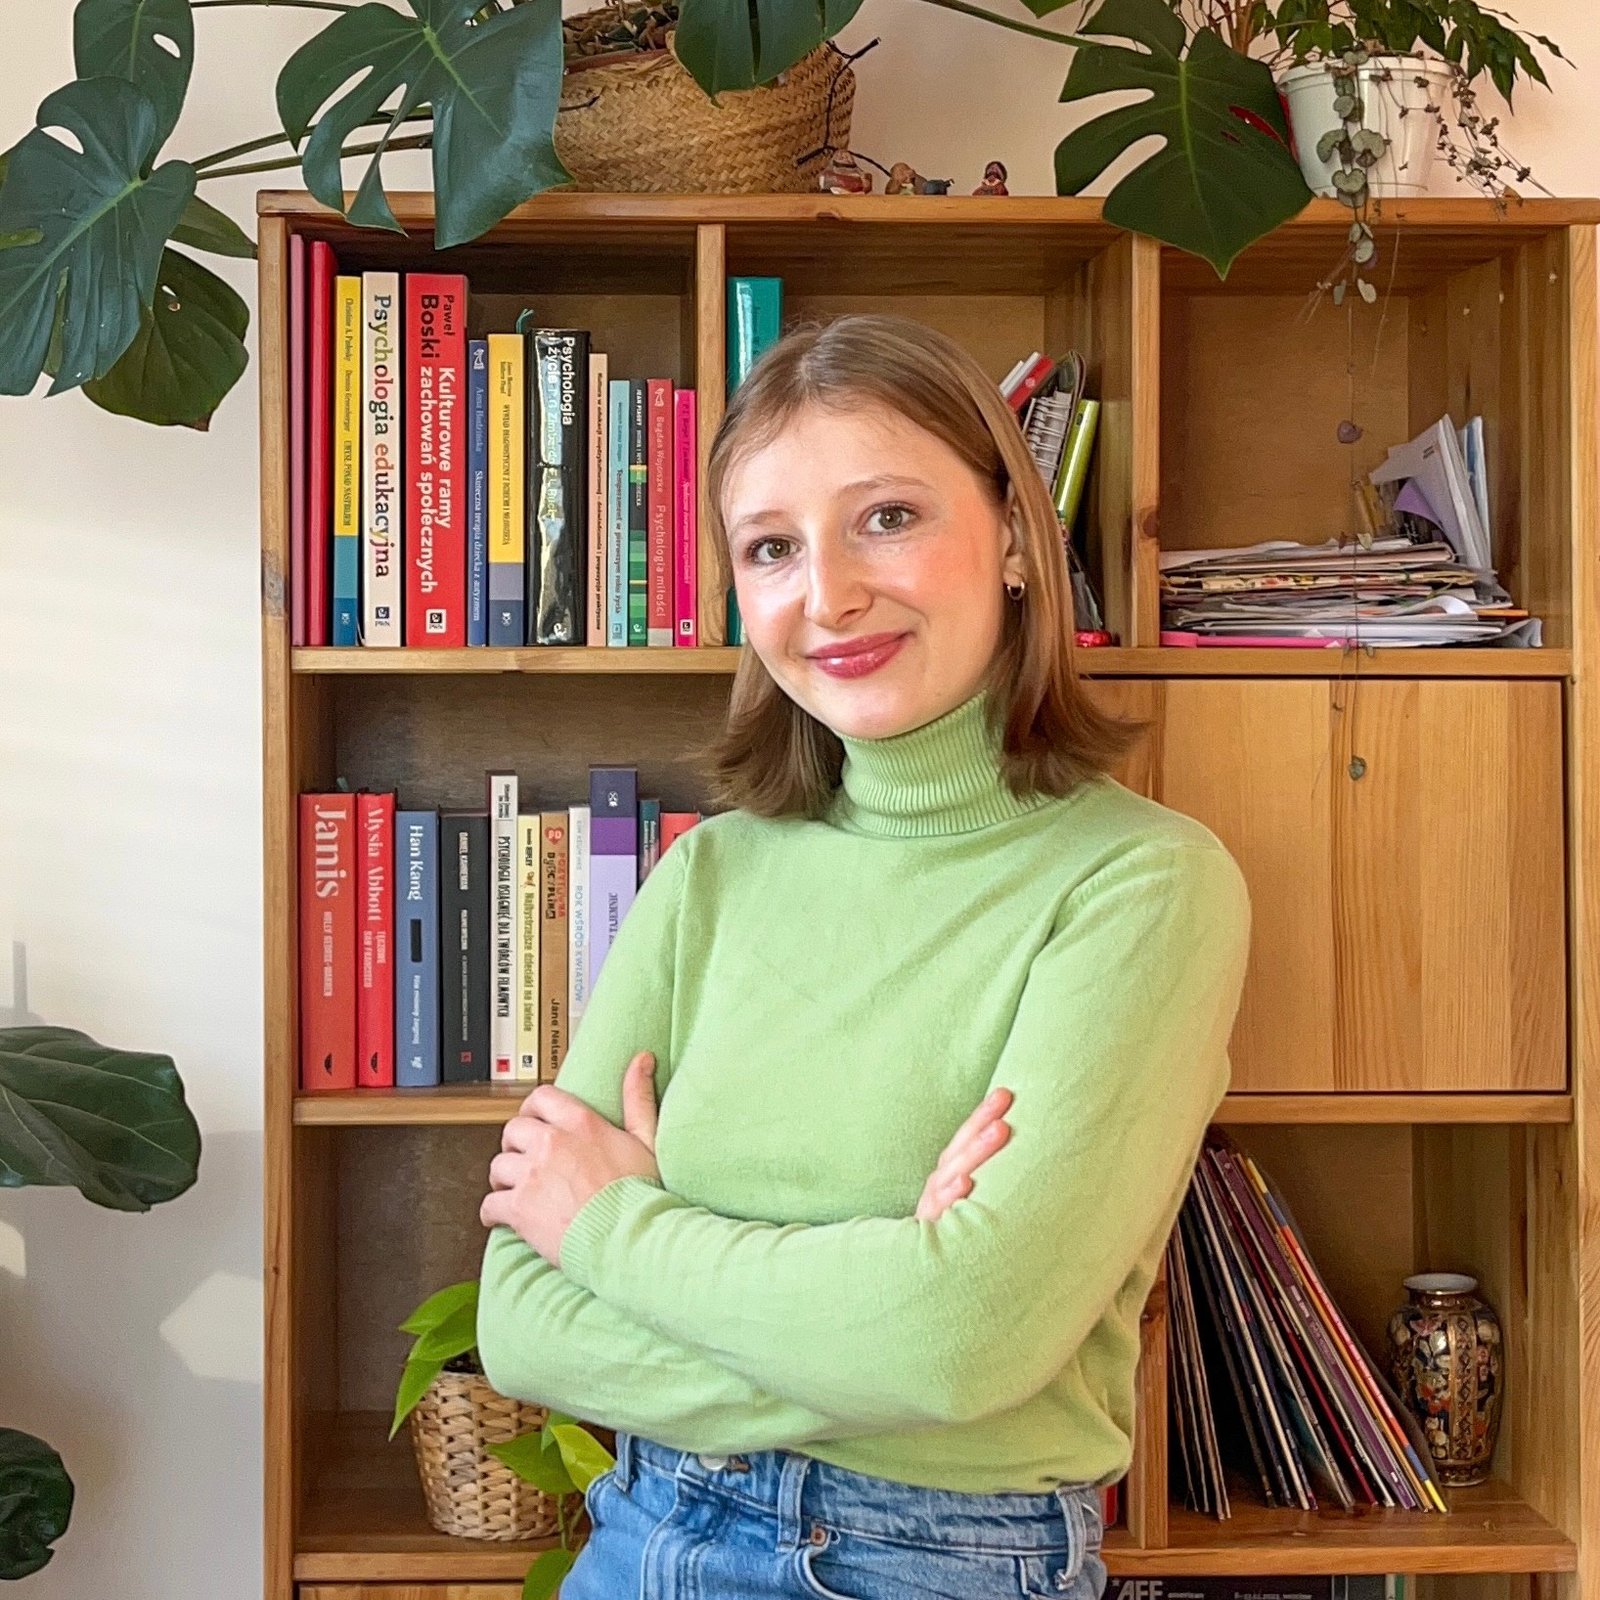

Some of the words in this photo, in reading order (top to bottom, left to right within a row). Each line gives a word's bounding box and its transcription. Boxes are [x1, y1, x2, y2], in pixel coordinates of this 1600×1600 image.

[420, 294, 440, 359] Boski
[442, 294, 457, 337] Paweł
[368, 295, 393, 436] Psychologia
[545, 347, 561, 384] życie
[560, 337, 575, 425] Psychologia
[419, 366, 438, 466] zachowań
[437, 366, 457, 473] Kulturowe
[654, 417, 665, 449] Bogdan
[368, 443, 394, 579] edukacyjna
[434, 478, 453, 529] ramy
[474, 470, 483, 511] Skuteczna
[415, 471, 438, 594] społecznych
[472, 512, 482, 539] terapia
[653, 505, 666, 572] Psychologia
[473, 541, 483, 572] dziecka
[472, 580, 481, 621] autyzmem
[655, 576, 666, 616] miłości
[314, 804, 347, 898] Janis
[364, 808, 384, 857] Alysia
[409, 825, 423, 857] Han
[498, 836, 511, 882] PSYCHOLOGIA
[367, 866, 384, 921] Abbott
[406, 860, 423, 900] Kang
[575, 885, 583, 906] ROK
[497, 884, 513, 920] OSIĄGNIĘĆ
[608, 892, 619, 933] TAJEMNIC
[498, 922, 510, 935] DLA
[575, 909, 586, 948] WŚRÓD
[497, 938, 512, 974] TWÓRCÓW
[523, 953, 534, 987] dzieciaki
[575, 951, 585, 1001] KWIATÓW
[497, 977, 510, 1018] FILMOWYCH
[524, 990, 532, 1000] na
[550, 998, 560, 1026] Jane
[550, 1030, 560, 1070] Nelsen
